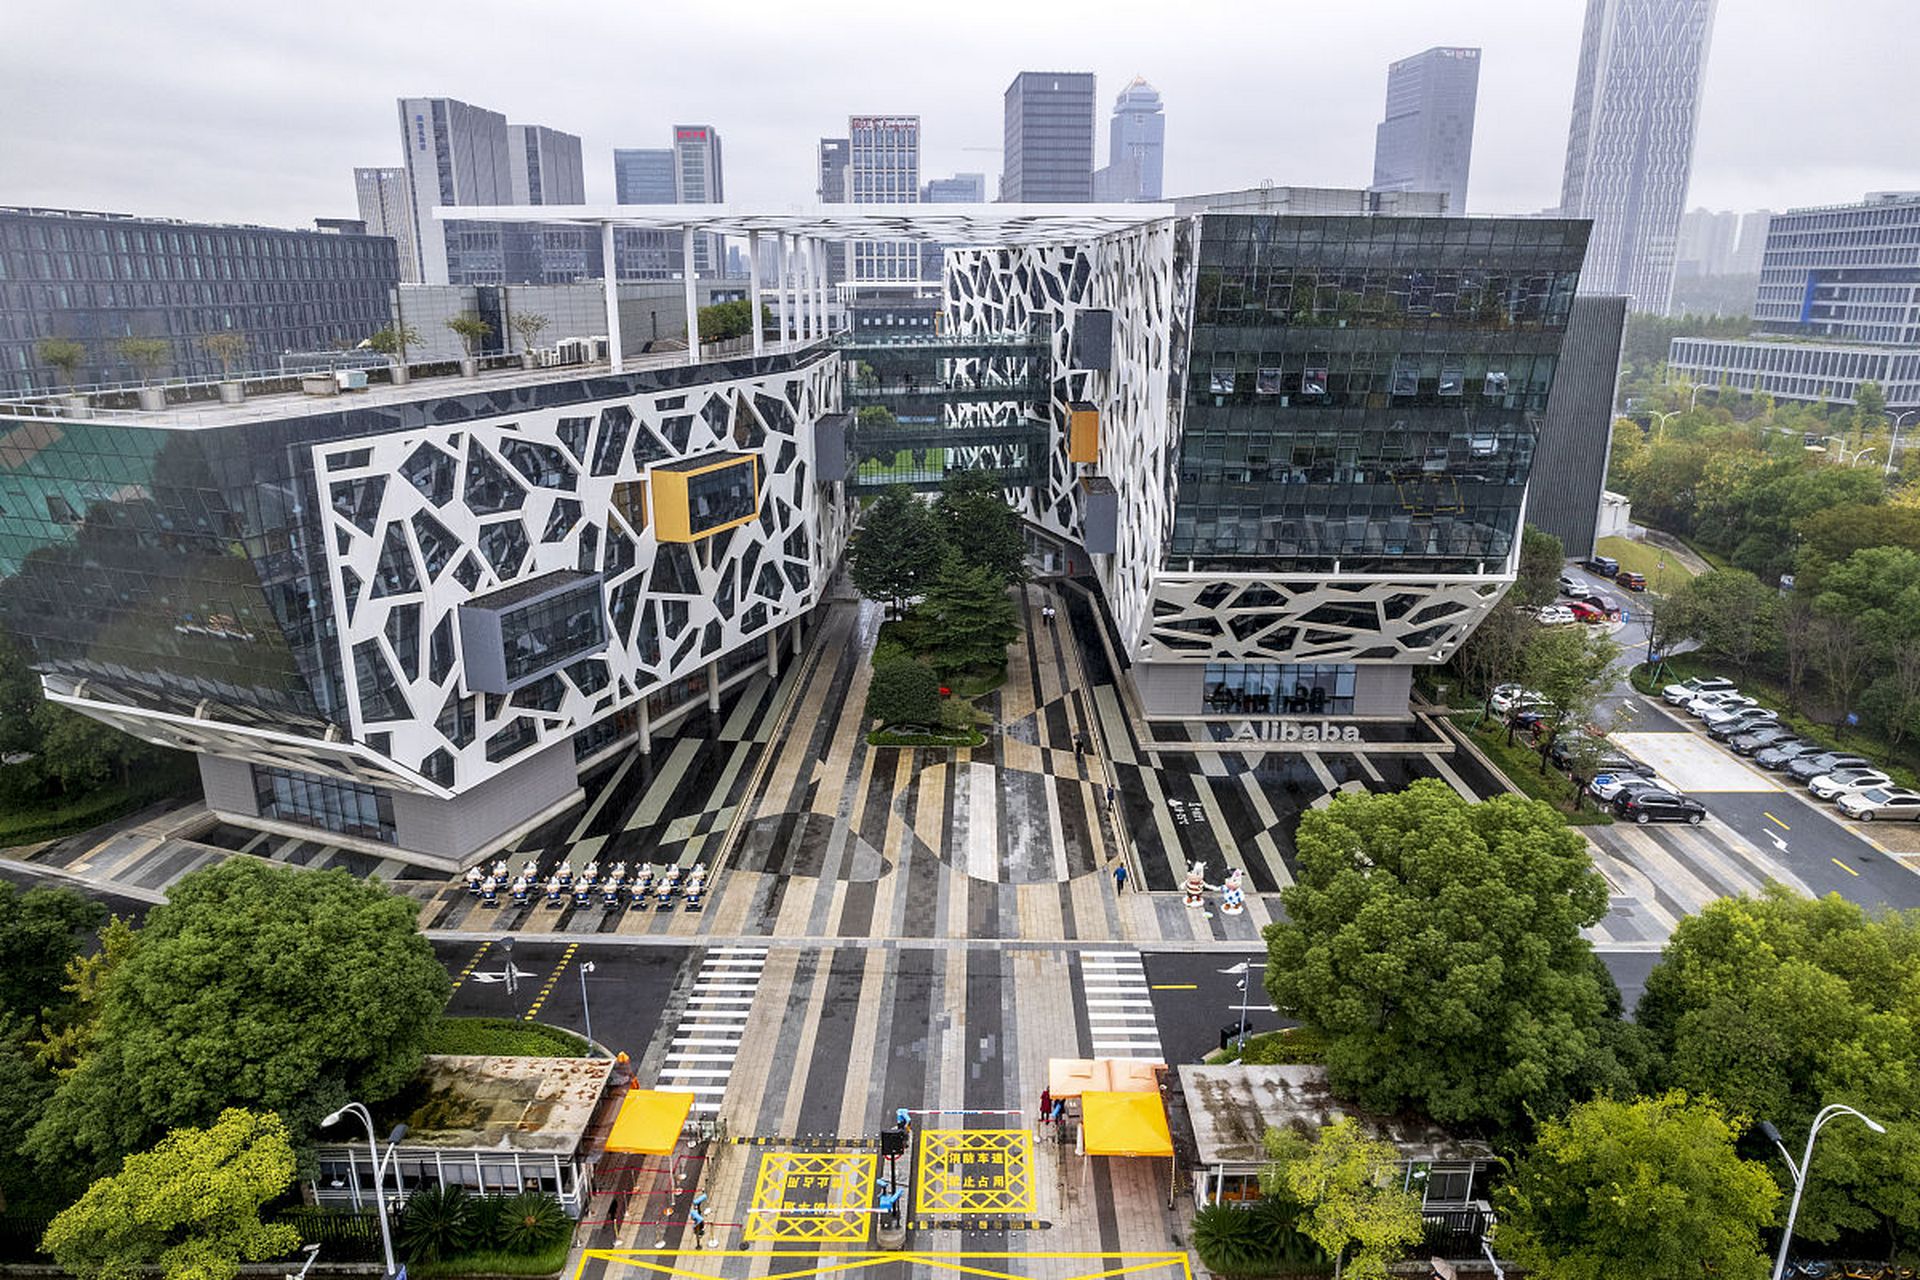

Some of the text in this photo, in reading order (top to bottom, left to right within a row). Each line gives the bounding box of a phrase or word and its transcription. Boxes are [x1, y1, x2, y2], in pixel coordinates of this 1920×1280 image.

[1232, 720, 1360, 742] Alibaba
[949, 1152, 1004, 1164] 消防车道
